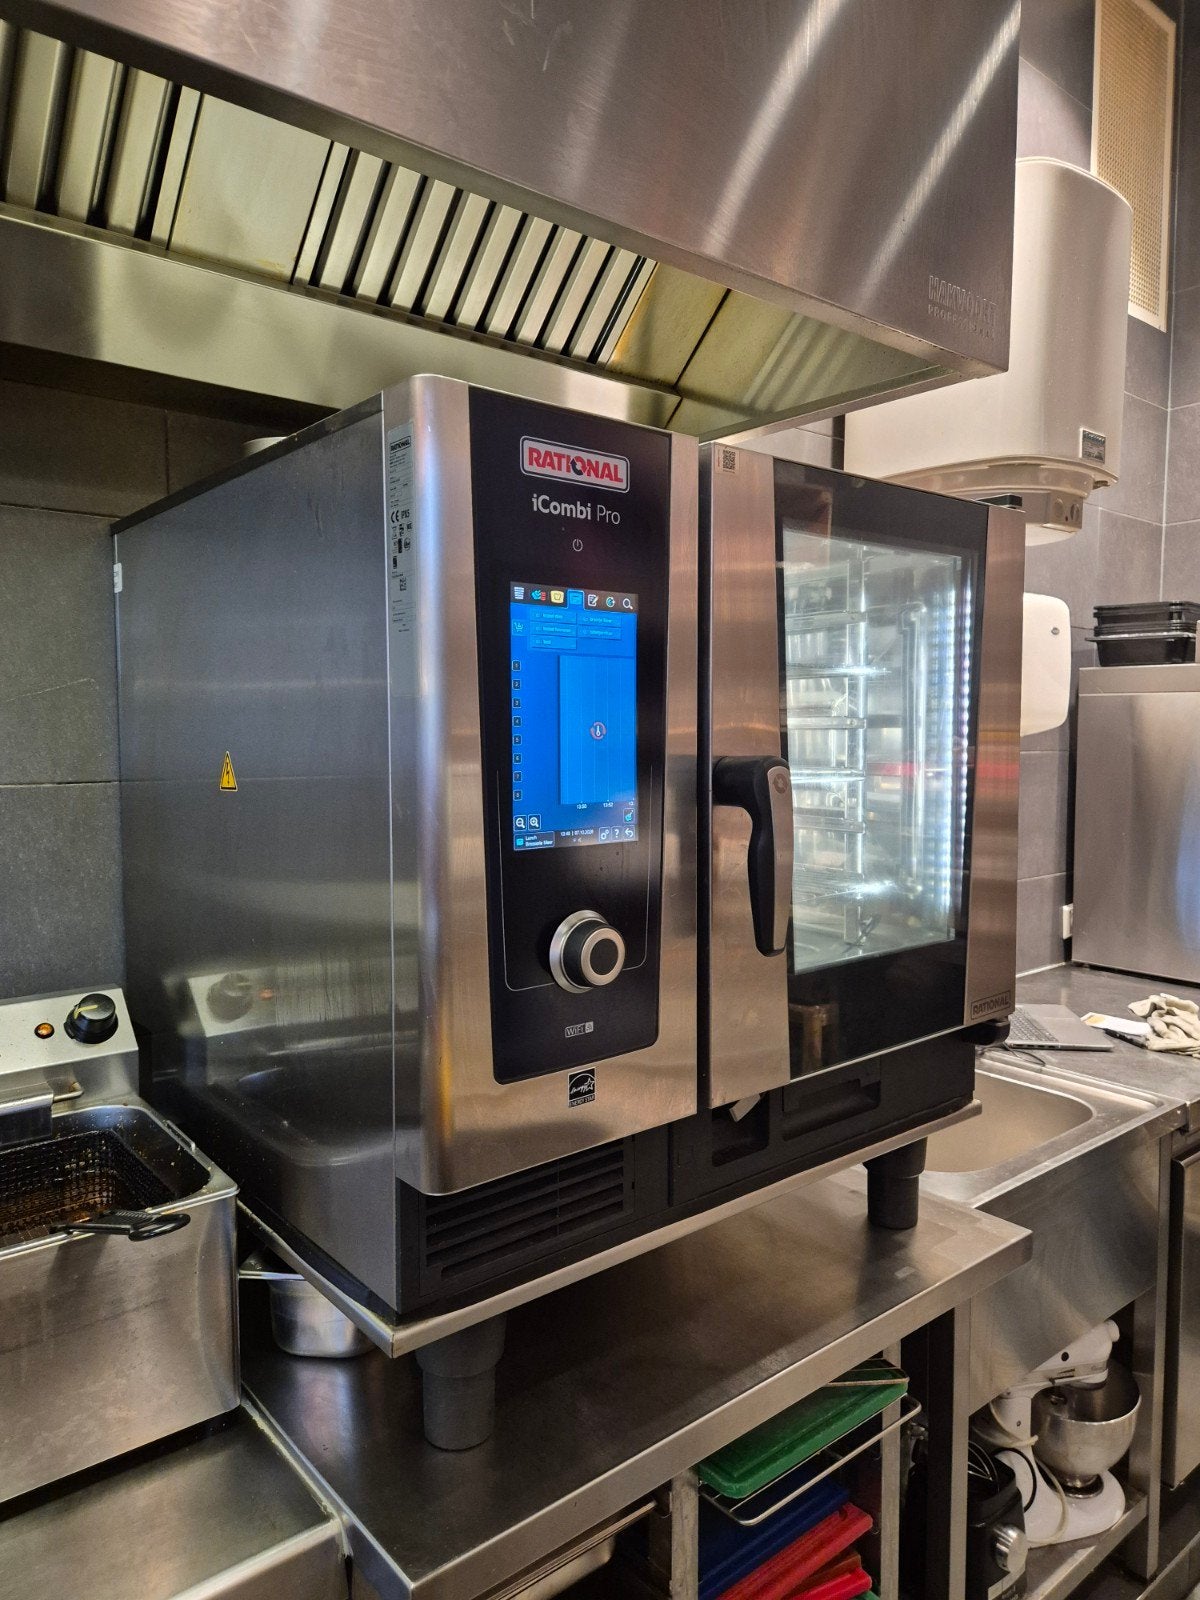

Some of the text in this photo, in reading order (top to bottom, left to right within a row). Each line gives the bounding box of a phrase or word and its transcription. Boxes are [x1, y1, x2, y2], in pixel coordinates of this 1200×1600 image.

[528, 446, 624, 483] RATIONAL
[531, 493, 621, 525] iCombi Pro
[972, 995, 1009, 1015] RATIONAL
